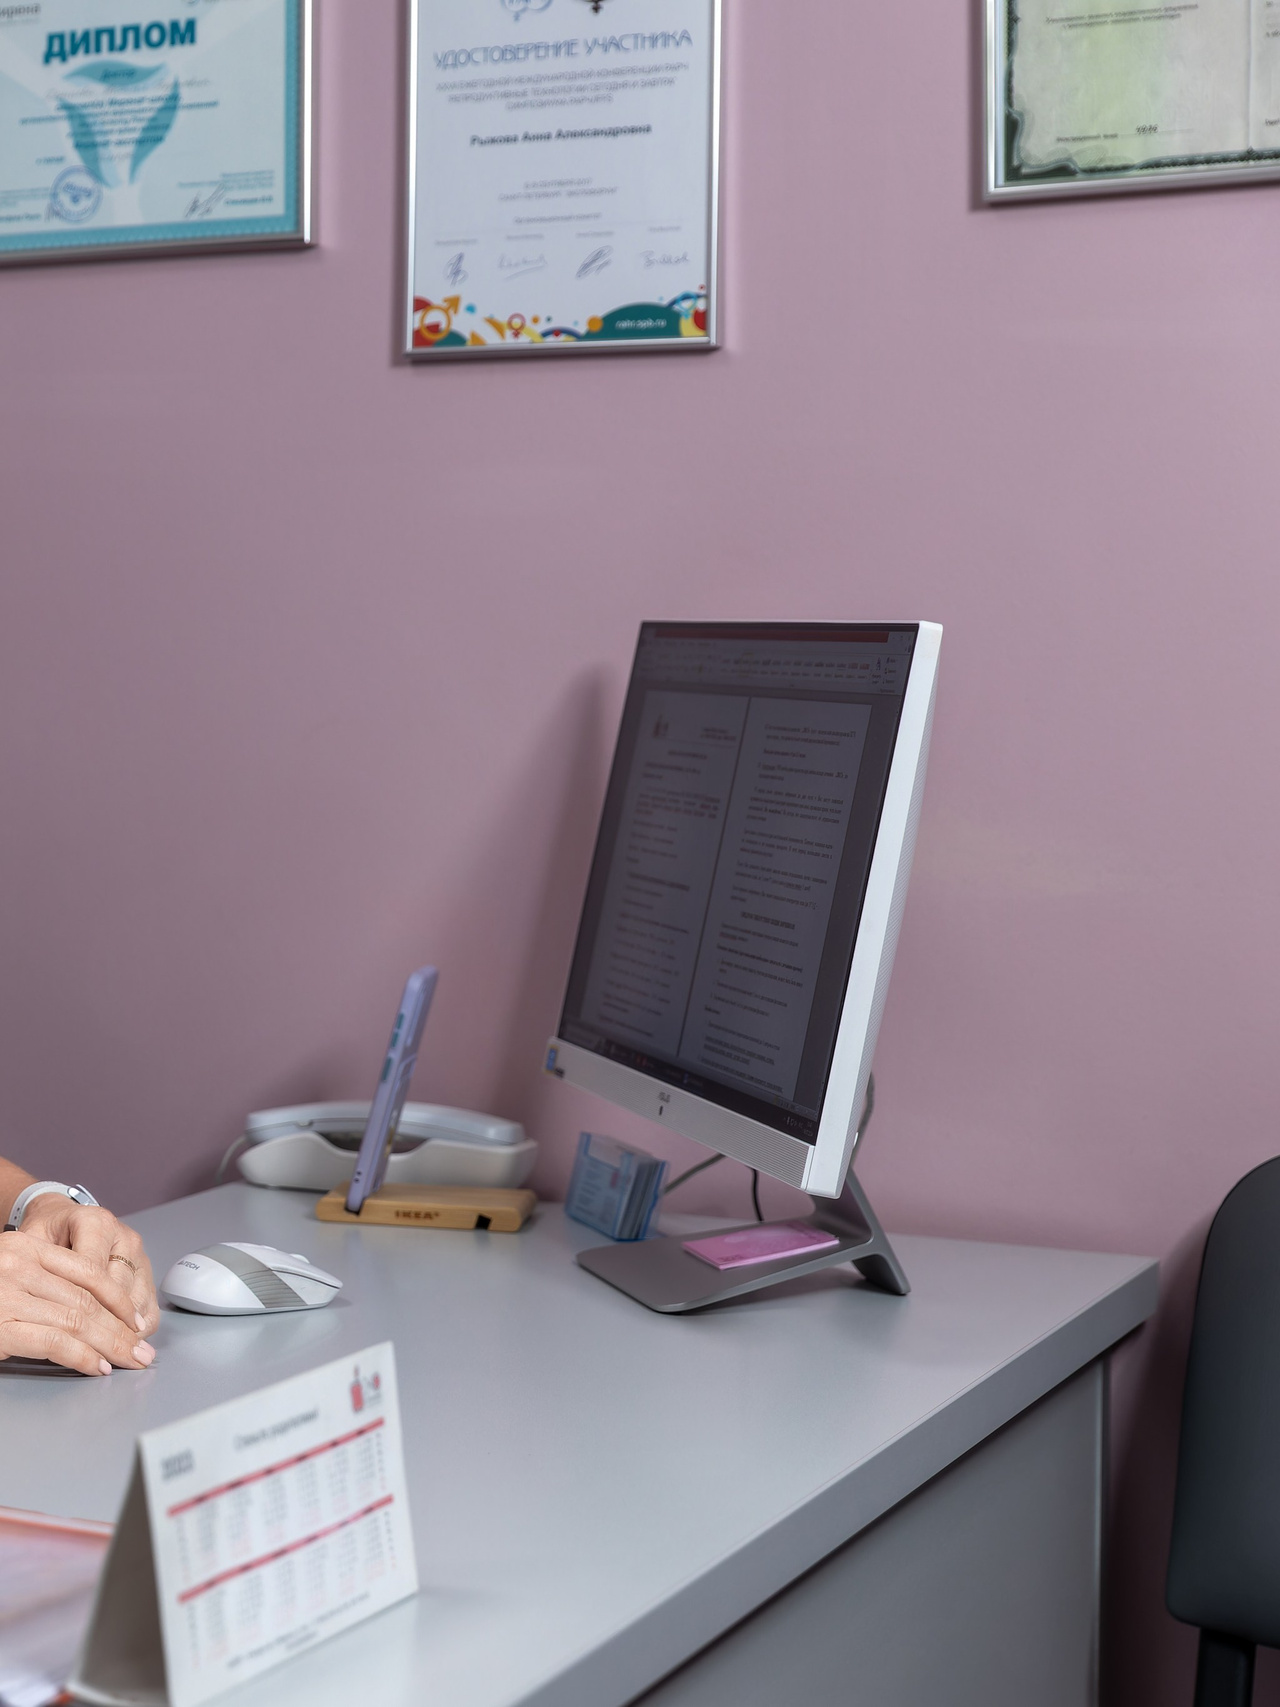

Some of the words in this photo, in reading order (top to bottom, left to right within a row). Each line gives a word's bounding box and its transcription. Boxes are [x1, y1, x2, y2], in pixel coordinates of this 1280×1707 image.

[41, 18, 197, 65] ДИПЛОМ
[433, 38, 579, 71] УДОСТОВЕРЕНИЕ
[583, 29, 693, 56] УЧАСТНИКА
